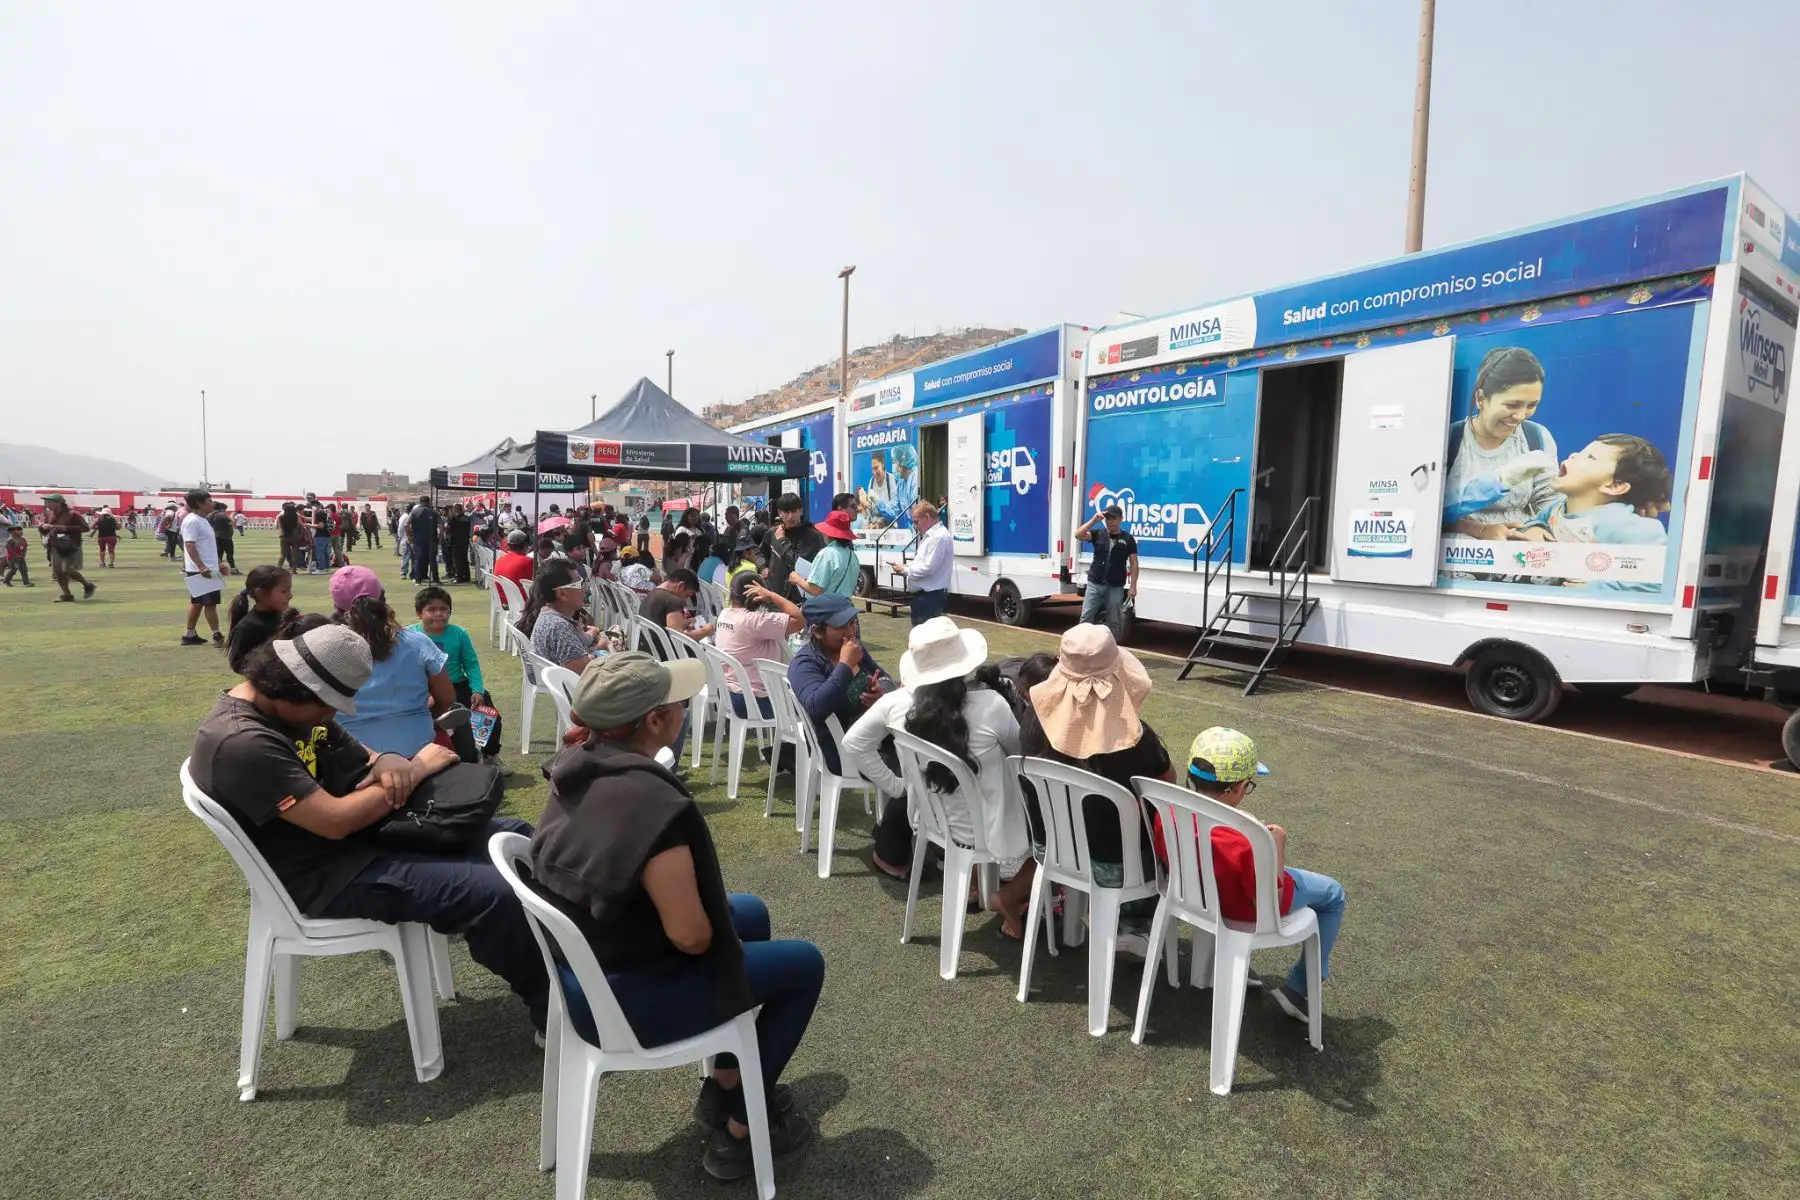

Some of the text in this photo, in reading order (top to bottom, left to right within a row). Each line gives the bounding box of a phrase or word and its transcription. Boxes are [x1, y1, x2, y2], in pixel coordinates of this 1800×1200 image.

[1283, 257, 1543, 325] Salud con compromiso social
[1170, 317, 1221, 341] MINSA
[1743, 319, 1774, 366] Minsa
[924, 358, 1012, 391] Salud con compromiso social
[880, 386, 901, 400] MINSA
[1094, 376, 1217, 411] ODONTOLOGÍA
[857, 427, 907, 448] ECOGRAFÍA
[597, 446, 619, 455] PERÚ
[728, 446, 786, 463] MINSA
[729, 463, 750, 471] DIRIS
[771, 465, 785, 473] SUR
[539, 474, 574, 484] MINSA
[1369, 480, 1398, 488] MINSA
[1130, 522, 1164, 537] Móvil
[1354, 520, 1407, 533] MINSA
[1446, 547, 1494, 559] MINSA
